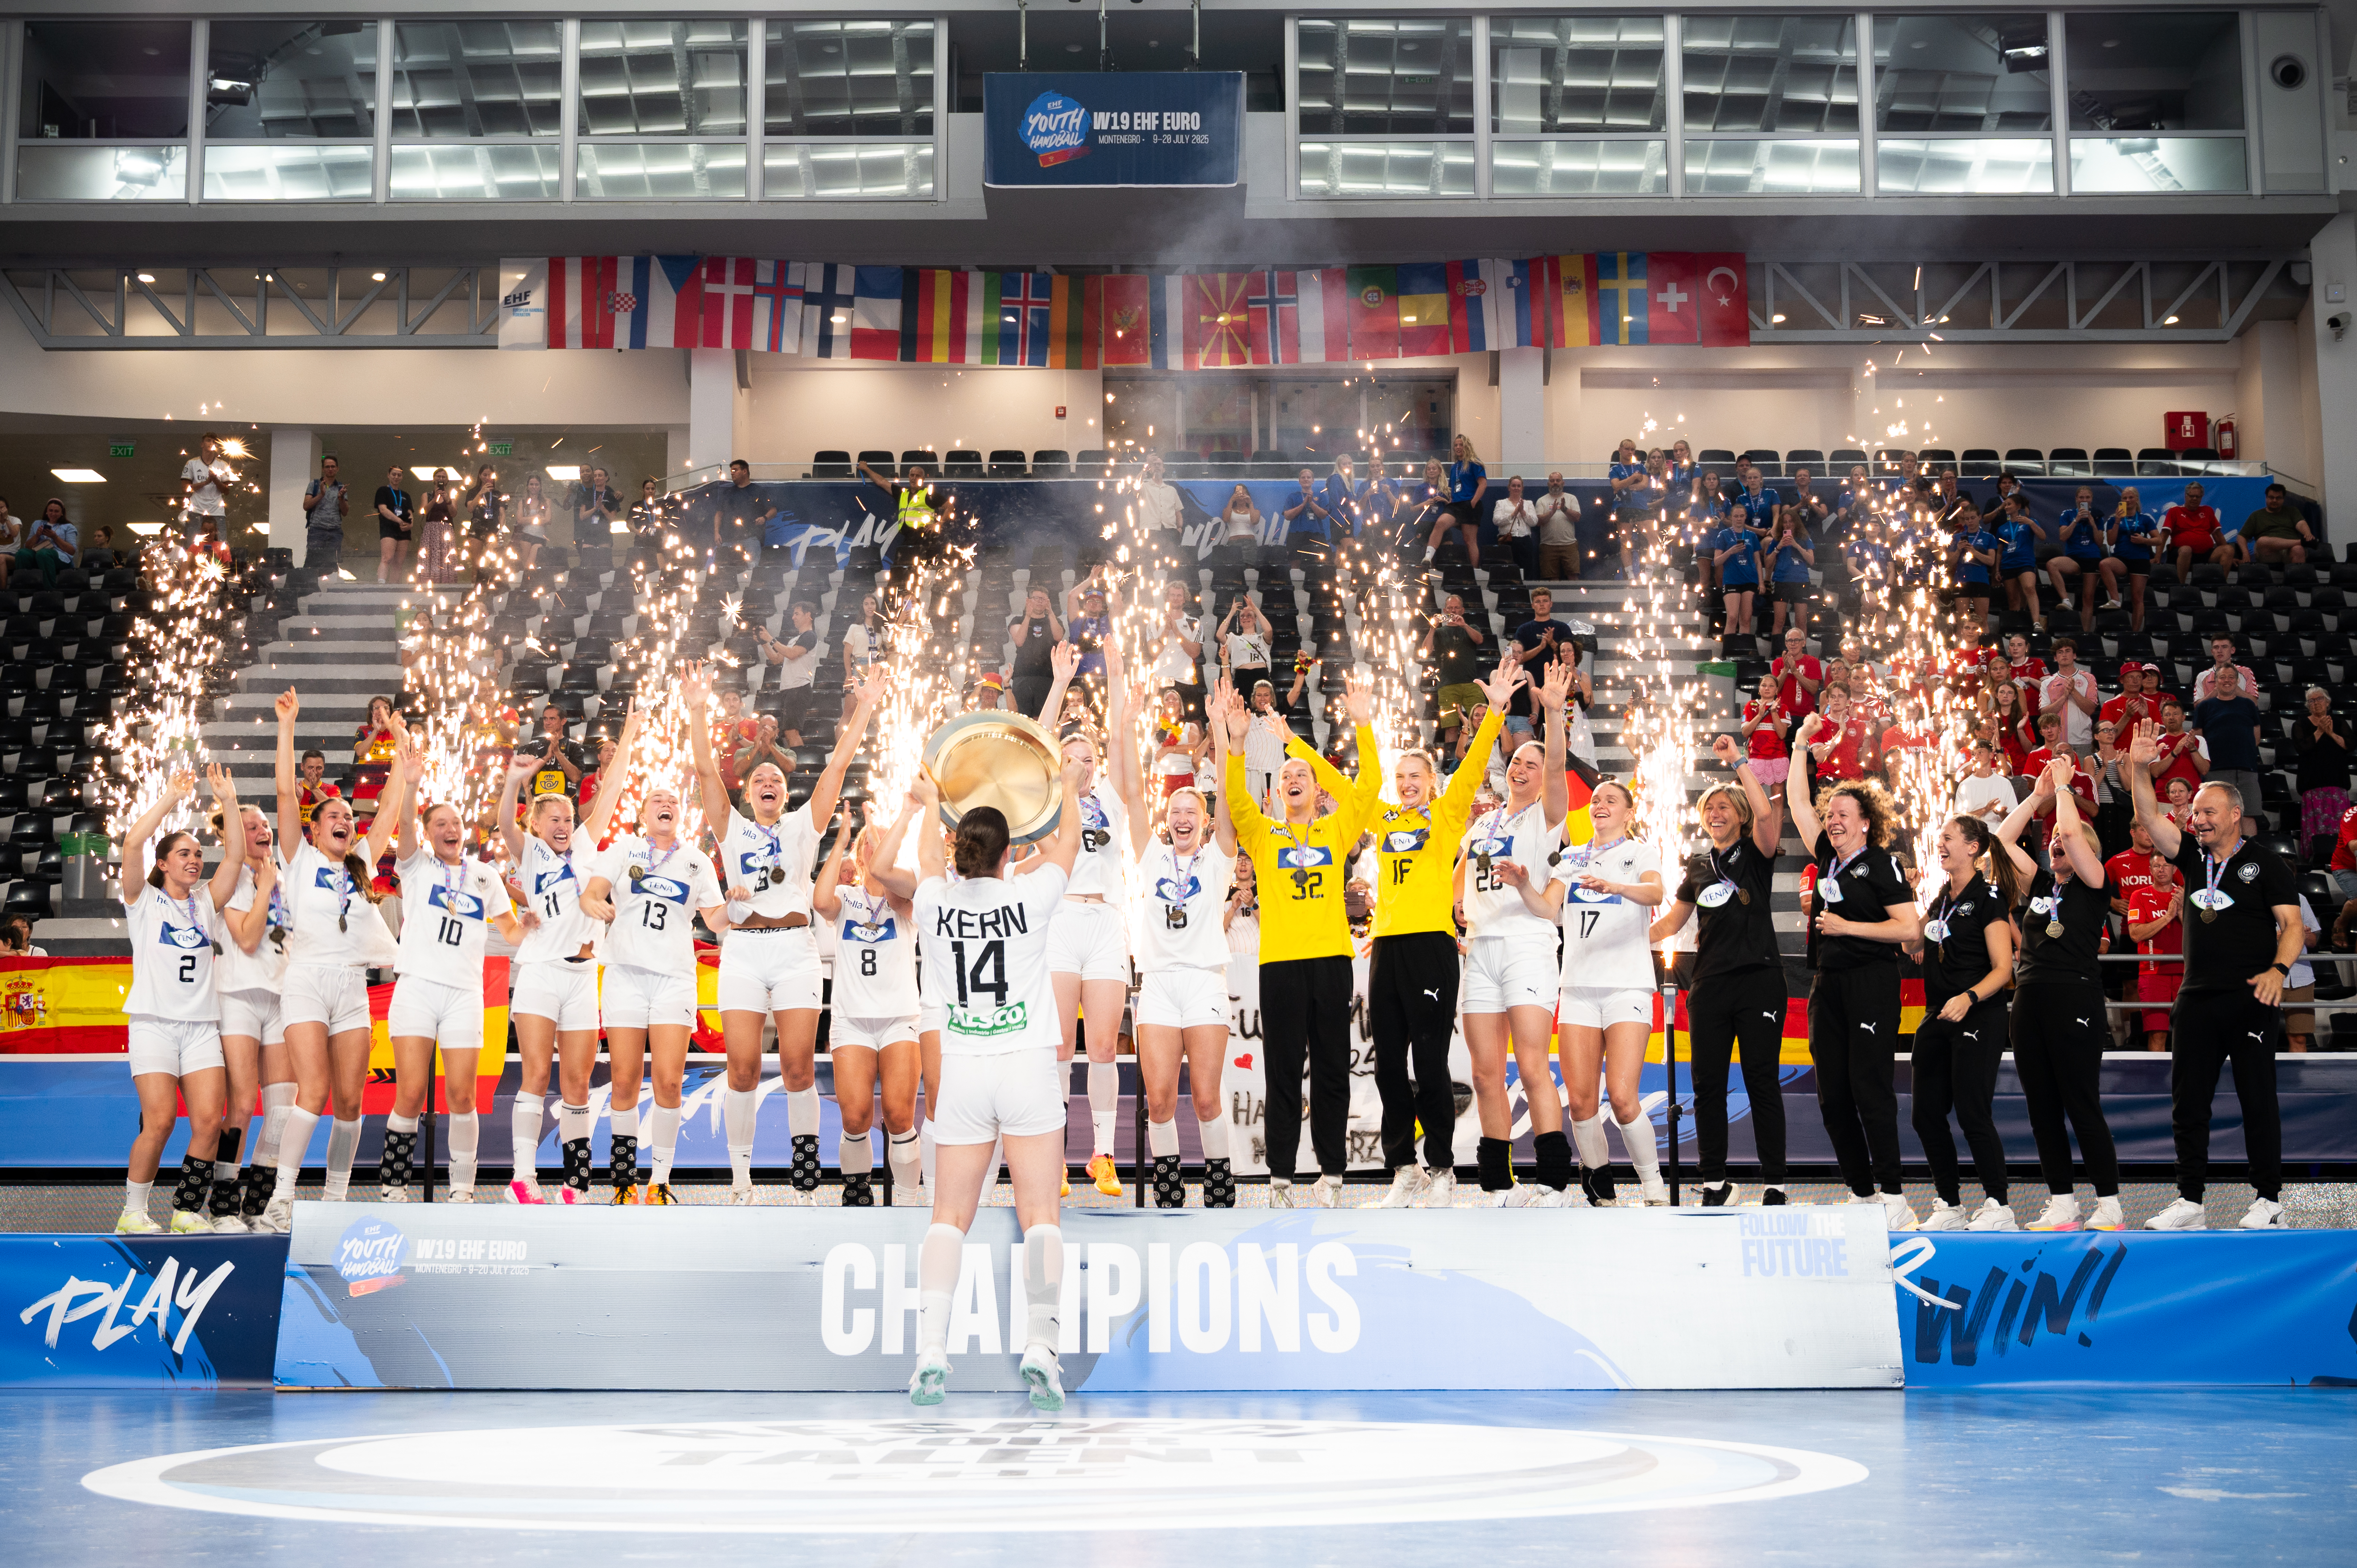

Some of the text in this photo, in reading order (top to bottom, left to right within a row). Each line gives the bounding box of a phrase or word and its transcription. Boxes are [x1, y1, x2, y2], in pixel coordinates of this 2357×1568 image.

[1047, 100, 1063, 109] EHF
[1028, 108, 1085, 136] YOUTH
[1093, 112, 1200, 130] W19 EHF EURO
[1030, 130, 1083, 148] HANDBALL
[1098, 135, 1140, 144] MONTENEGRO
[1173, 134, 1190, 144] JULY
[1191, 134, 1209, 144] 2025
[504, 290, 531, 305] EHF
[110, 447, 134, 456] EXIT
[488, 446, 512, 455] EXIT
[783, 512, 899, 566] PLAY
[1250, 652, 1259, 663] 18
[1294, 852, 1314, 861] TNA
[648, 881, 673, 893] TENA
[1289, 870, 1322, 898] 32
[2121, 875, 2154, 887] NORL
[843, 893, 863, 910] hella
[1703, 887, 1729, 903] TENA
[545, 891, 561, 918] 11
[643, 900, 668, 931] 13
[937, 902, 1028, 939] KERN
[1165, 903, 1187, 929] 15
[1580, 910, 1600, 938] 17
[176, 934, 198, 942] TENA
[437, 916, 463, 946] 10
[179, 955, 196, 983] 2
[861, 949, 877, 976] 8
[951, 940, 1009, 1009] 14
[364, 1224, 381, 1234] EHF
[1740, 1214, 1846, 1237] FOLLOW THE
[340, 1233, 404, 1263] YOUTH
[416, 1239, 527, 1261] W19 EHF EURO
[340, 1257, 399, 1277] HANDBALL
[1741, 1238, 1848, 1278] FUTURE
[415, 1263, 462, 1274] MONTENEGRO
[491, 1264, 508, 1274] JULY
[511, 1264, 529, 1275] 2025
[20, 1256, 236, 1355] PLAY
[613, 1422, 1410, 1439] RESPECT
[833, 1436, 1180, 1446] YOUR
[658, 1448, 1327, 1465] TALENT
